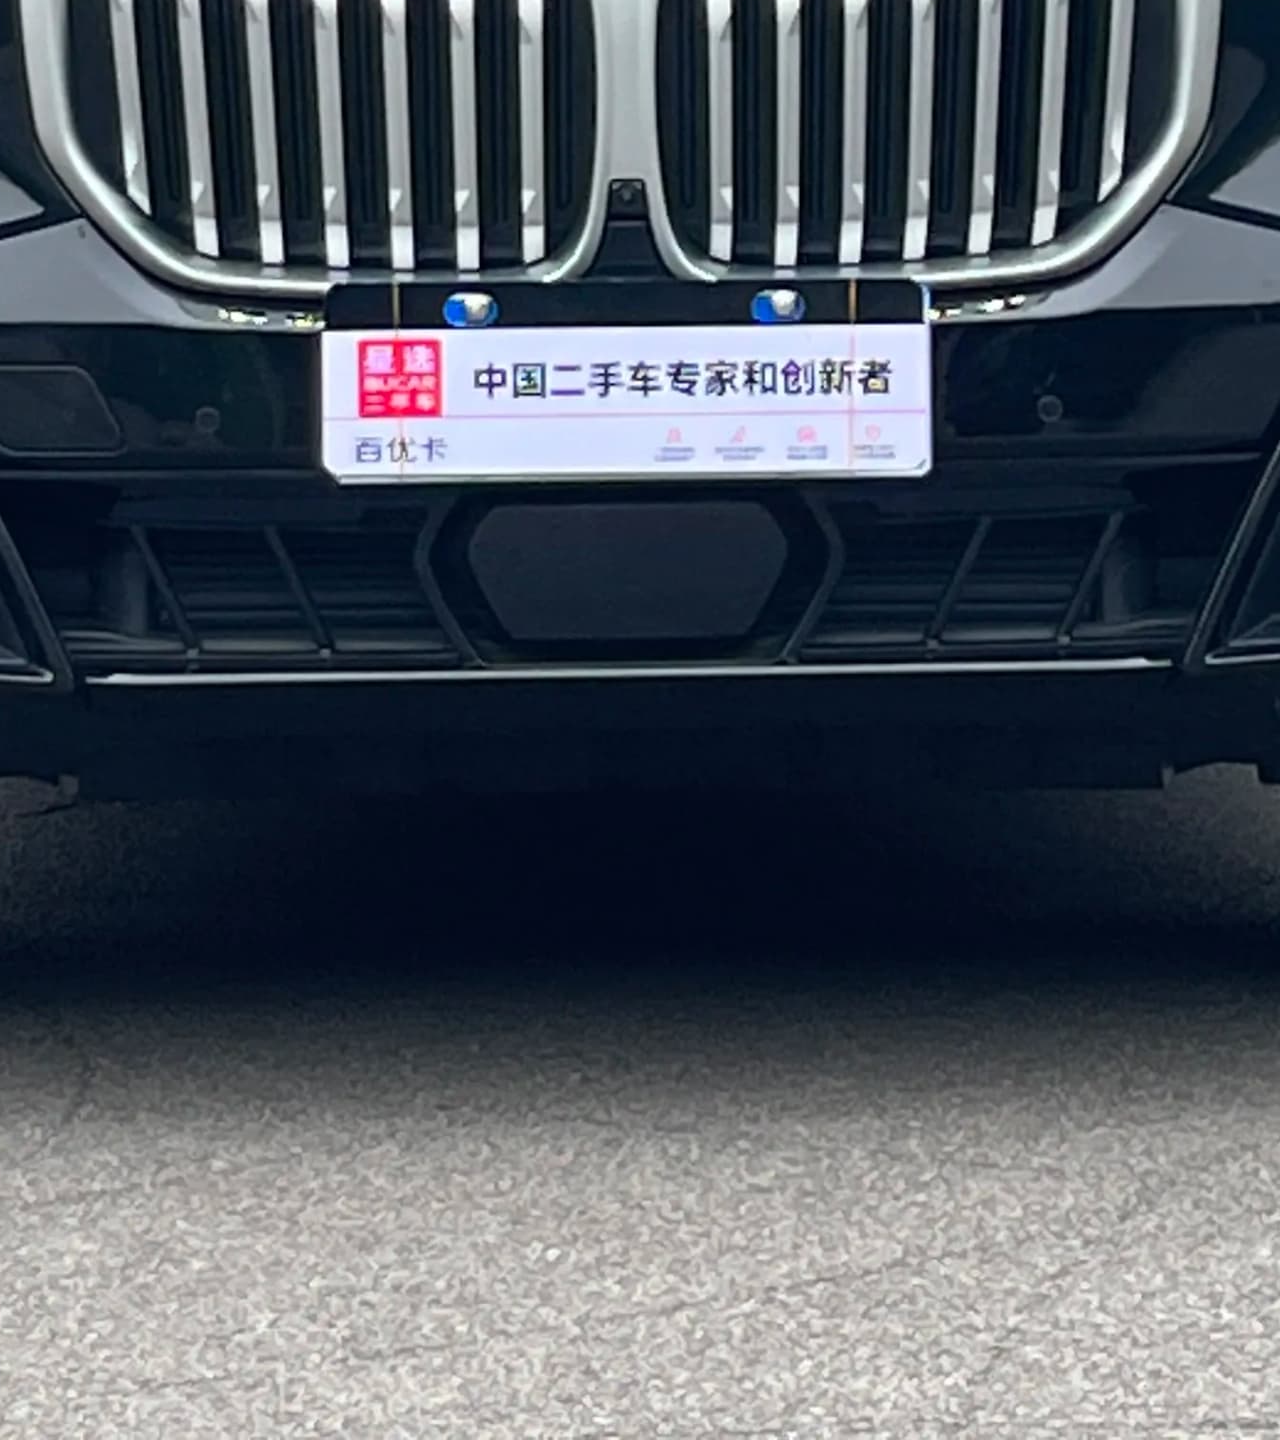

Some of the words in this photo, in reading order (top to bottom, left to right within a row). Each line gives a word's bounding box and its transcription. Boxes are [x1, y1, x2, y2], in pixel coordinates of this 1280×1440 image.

[474, 359, 892, 398] 中国二手车专家和创新者
[355, 436, 448, 463] 百优卡
